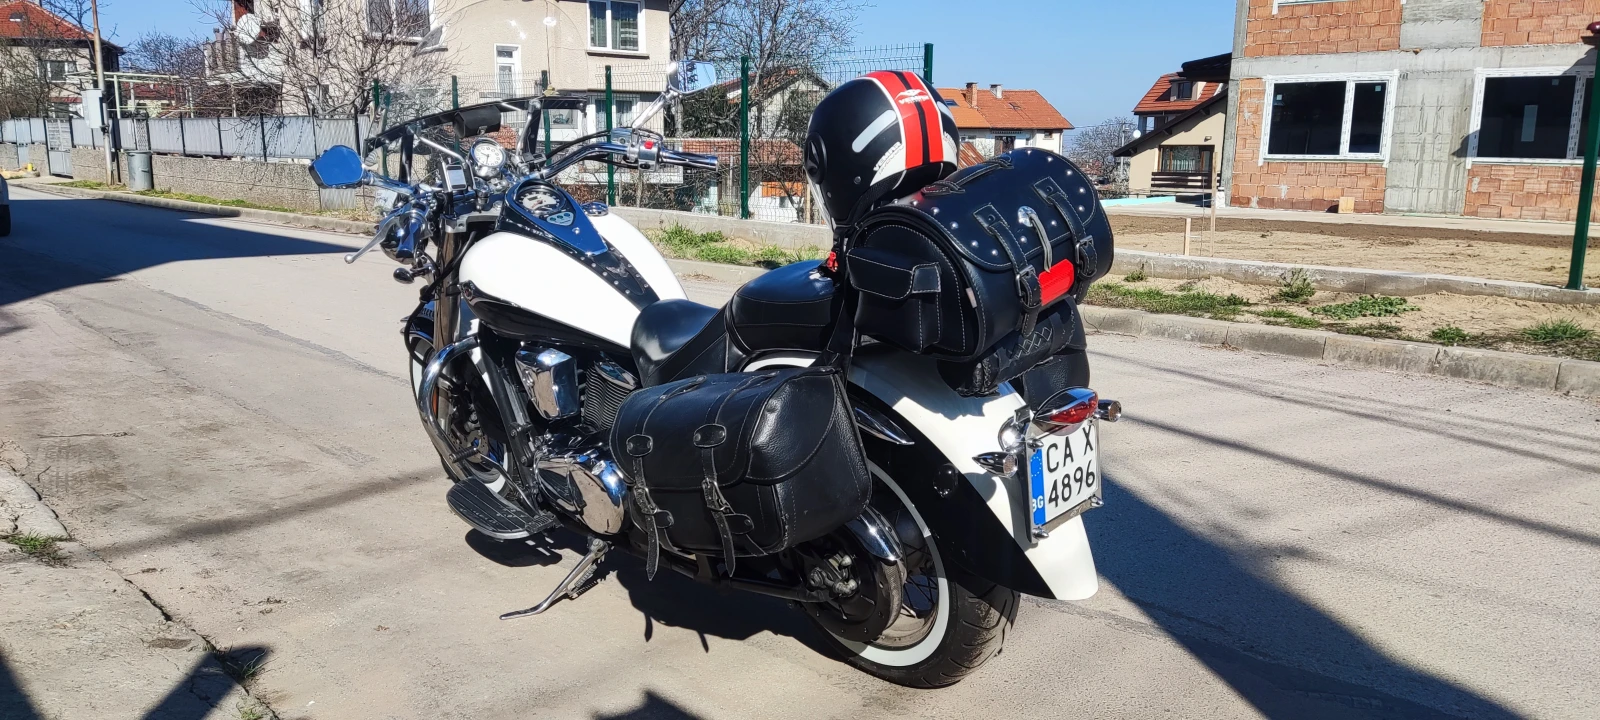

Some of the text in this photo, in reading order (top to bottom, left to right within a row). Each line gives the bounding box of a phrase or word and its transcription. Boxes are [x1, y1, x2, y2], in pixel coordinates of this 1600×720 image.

[873, 141, 902, 171] VEMAR
[1046, 424, 1094, 473] CA X
[1048, 459, 1095, 508] 4896
